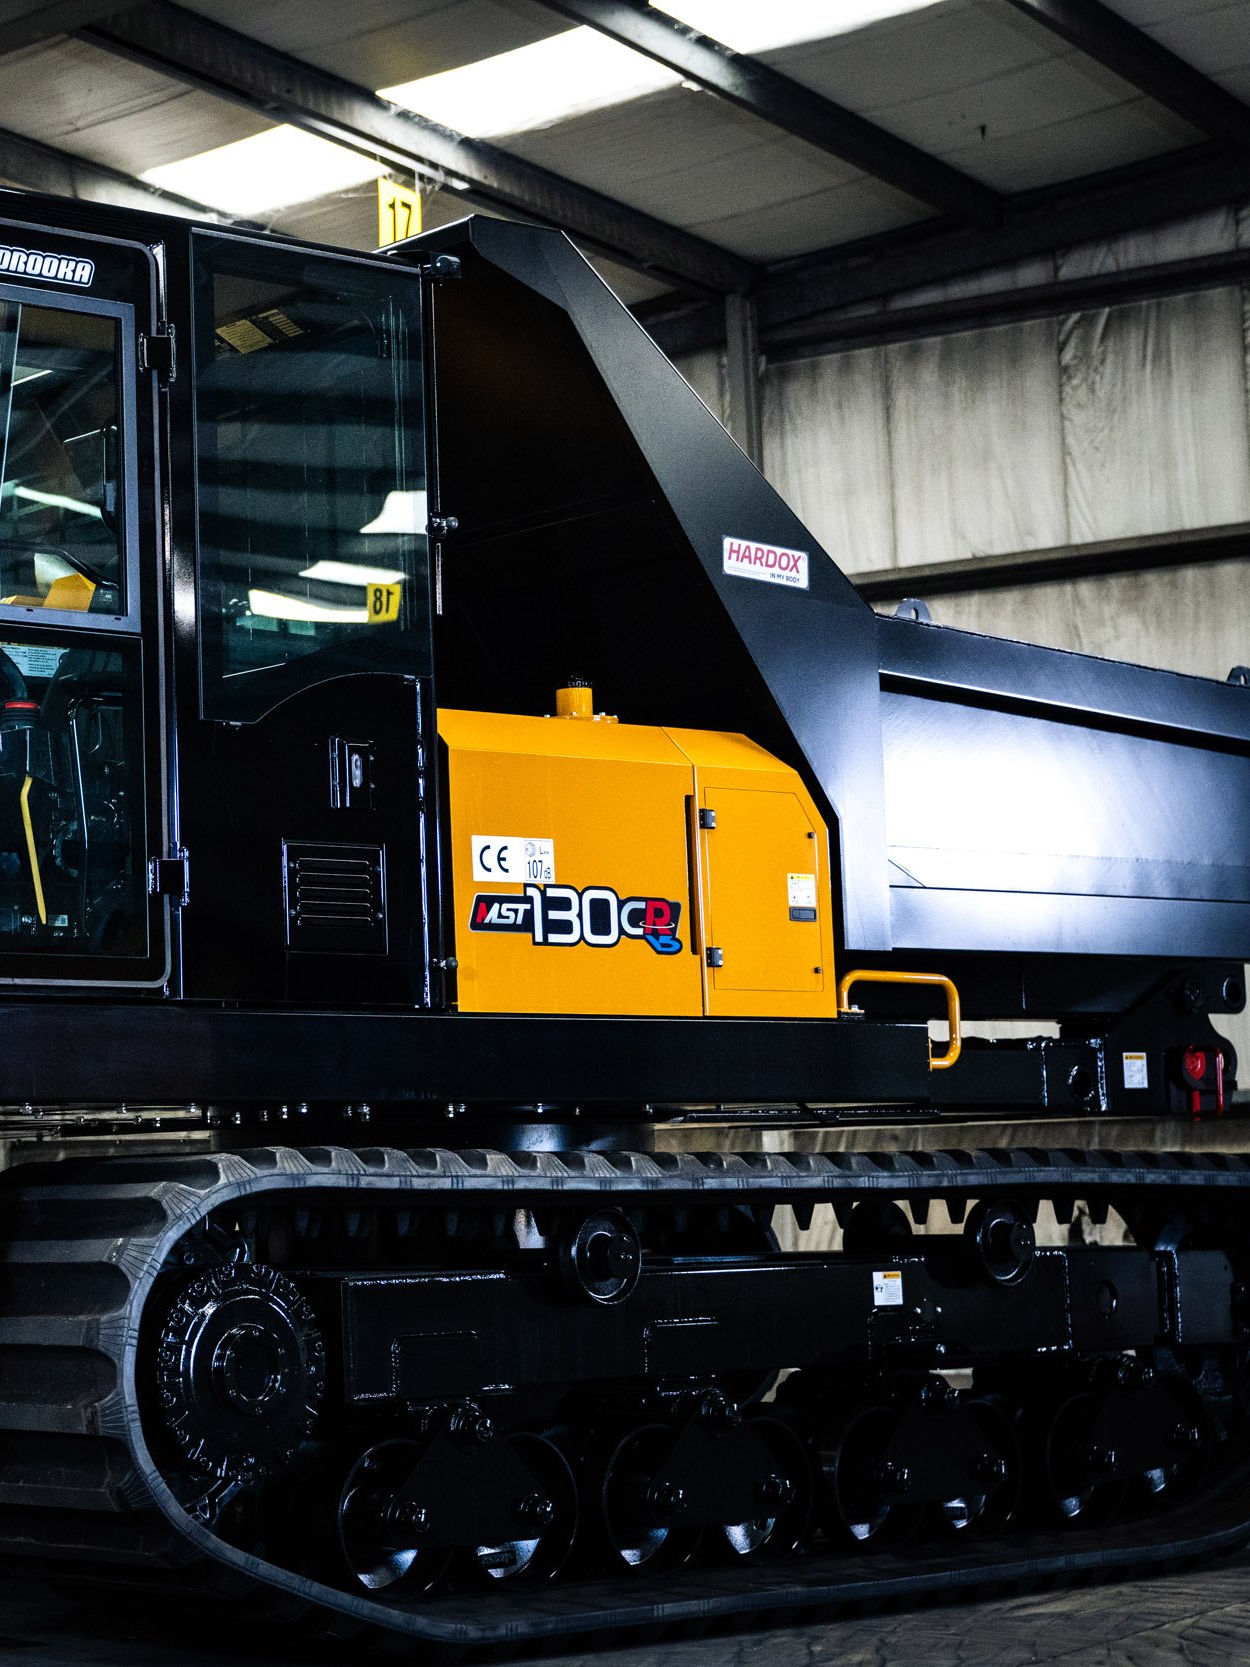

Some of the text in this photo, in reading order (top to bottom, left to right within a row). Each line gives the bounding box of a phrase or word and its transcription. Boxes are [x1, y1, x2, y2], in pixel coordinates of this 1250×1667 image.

[388, 197, 412, 242] 17
[727, 541, 802, 574] HARDOX
[479, 844, 510, 873] CE
[526, 859, 543, 879] 107
